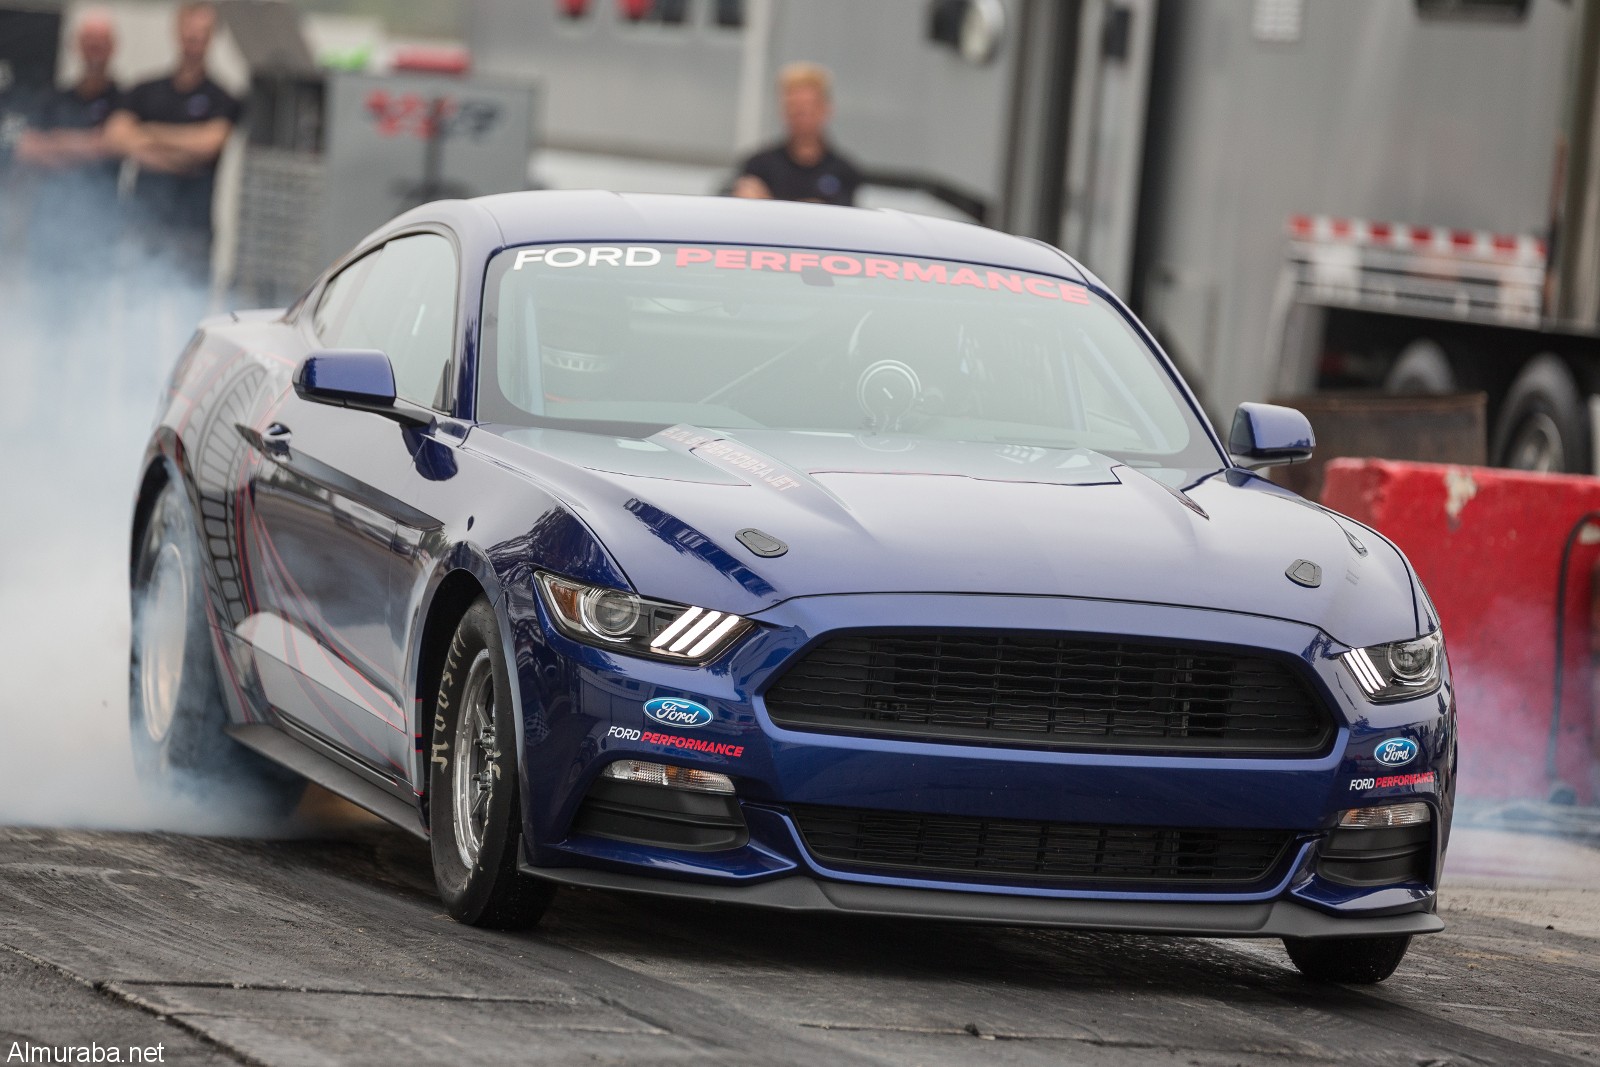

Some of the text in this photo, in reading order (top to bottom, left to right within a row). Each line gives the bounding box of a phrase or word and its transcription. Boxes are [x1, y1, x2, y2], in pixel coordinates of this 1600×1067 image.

[513, 247, 1091, 305] FORD PERFORMANCE
[721, 451, 774, 477] COBRA
[766, 475, 801, 491] JET
[656, 701, 700, 725] Ford
[607, 725, 745, 758] FORD PERFORMANCE
[1383, 742, 1410, 762] Ford
[1349, 771, 1435, 791] FORD PERFORMANCE
